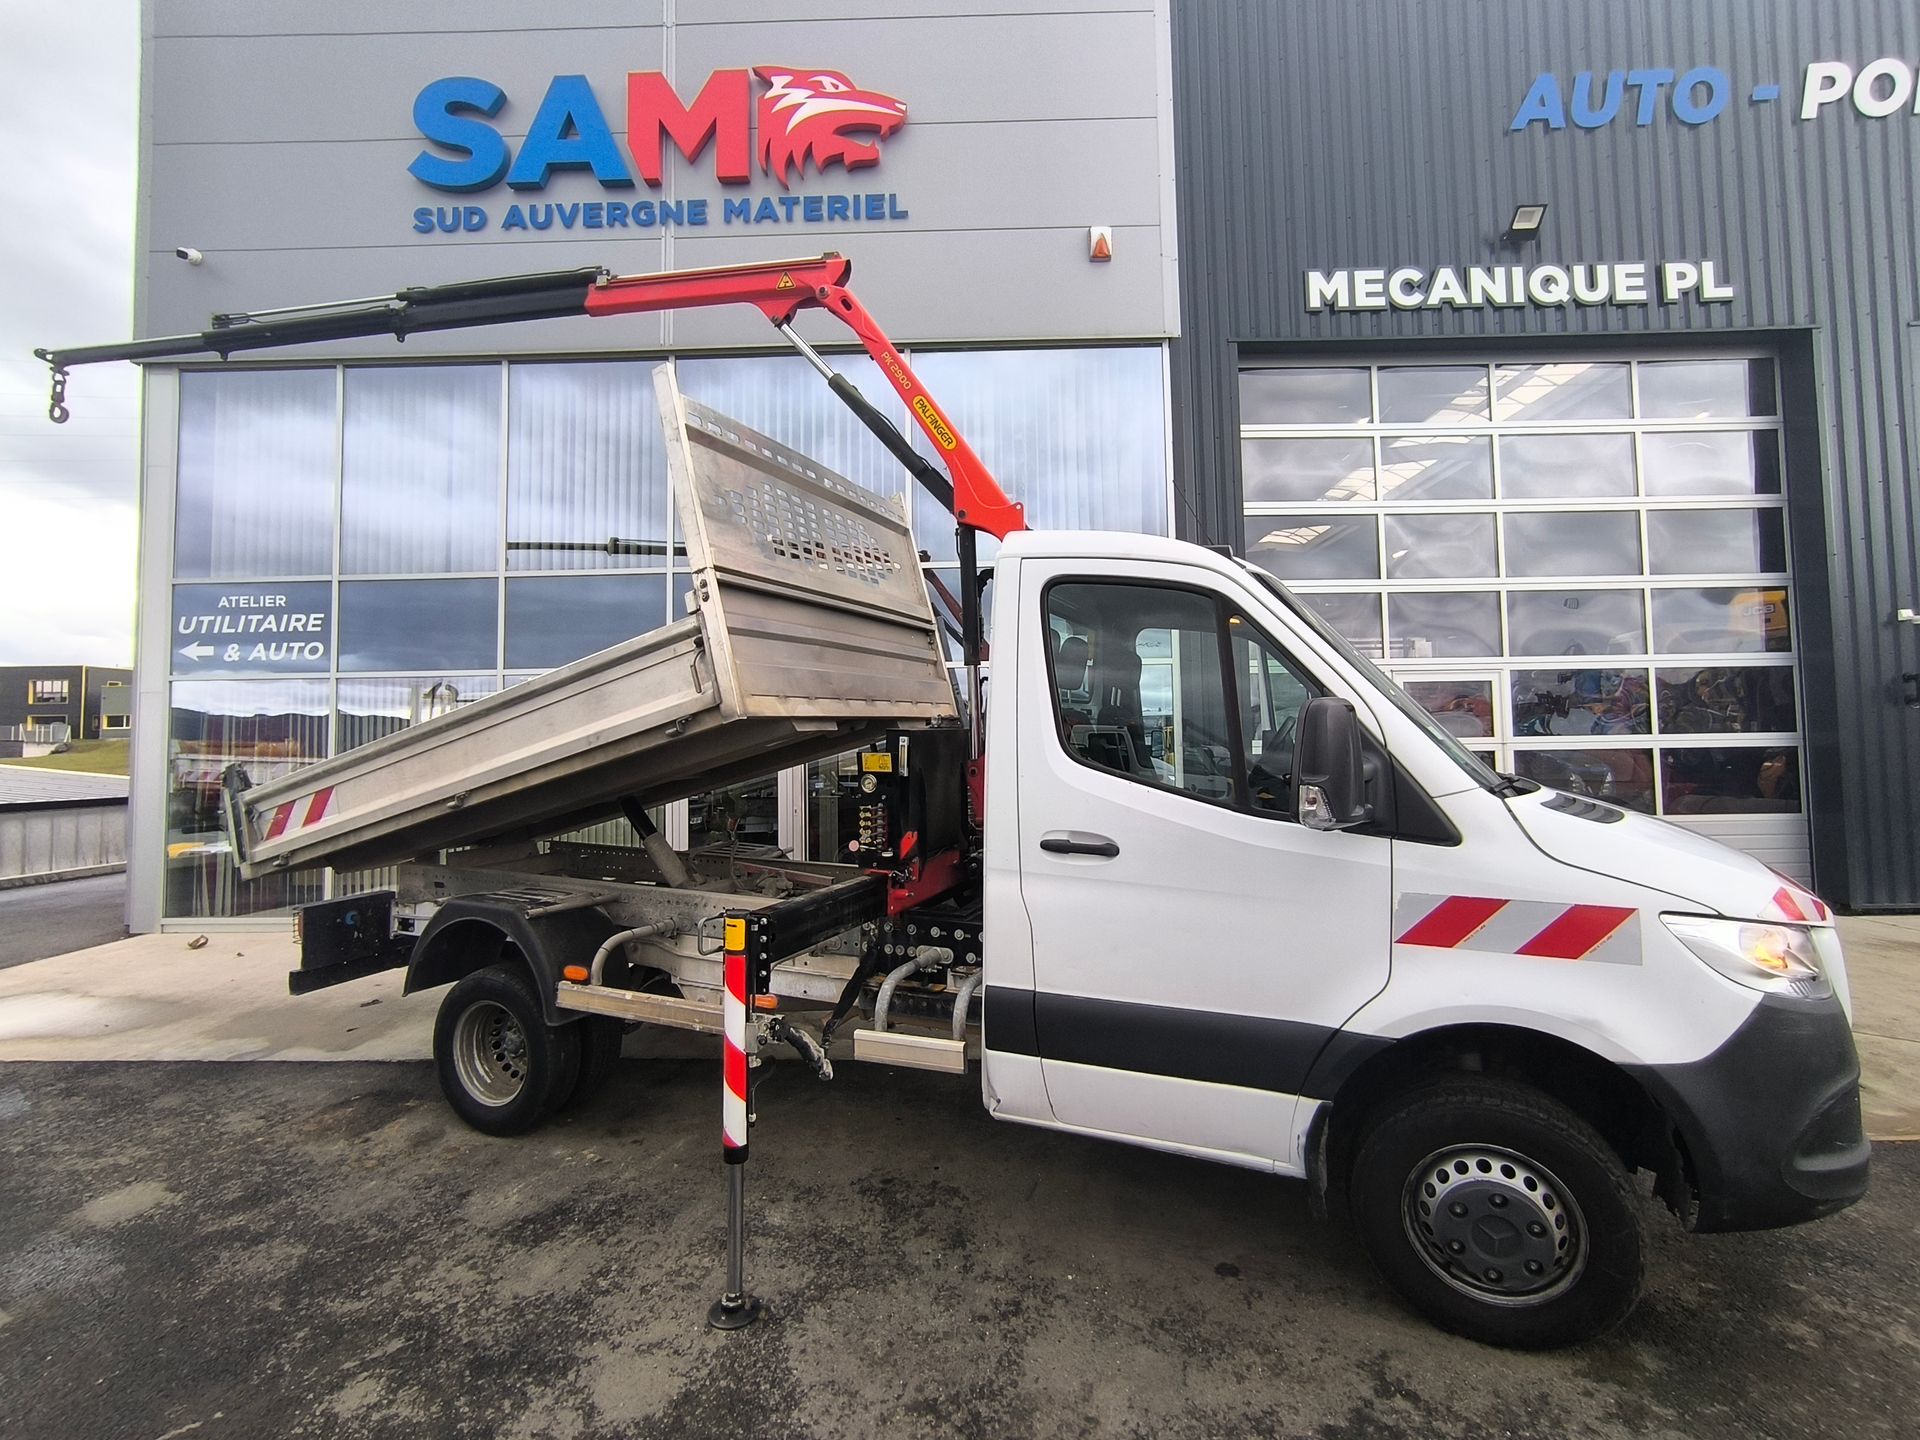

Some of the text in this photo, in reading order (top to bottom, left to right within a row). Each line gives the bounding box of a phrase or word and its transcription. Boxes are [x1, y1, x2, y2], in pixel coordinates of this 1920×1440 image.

[1510, 67, 1730, 131] AUTO
[1801, 57, 1920, 120] PO
[407, 69, 753, 193] SAM
[413, 193, 909, 234] SUD AUVERGNE MATERIEL
[1306, 260, 1734, 309] MECANIQUE PL
[881, 351, 912, 390] PK 2900
[915, 398, 954, 447] PALFINGER
[218, 595, 287, 608] ATELIER
[1743, 603, 1775, 617] JCB
[178, 613, 325, 635] UTILITAIRE
[223, 641, 325, 662] & AUTO
